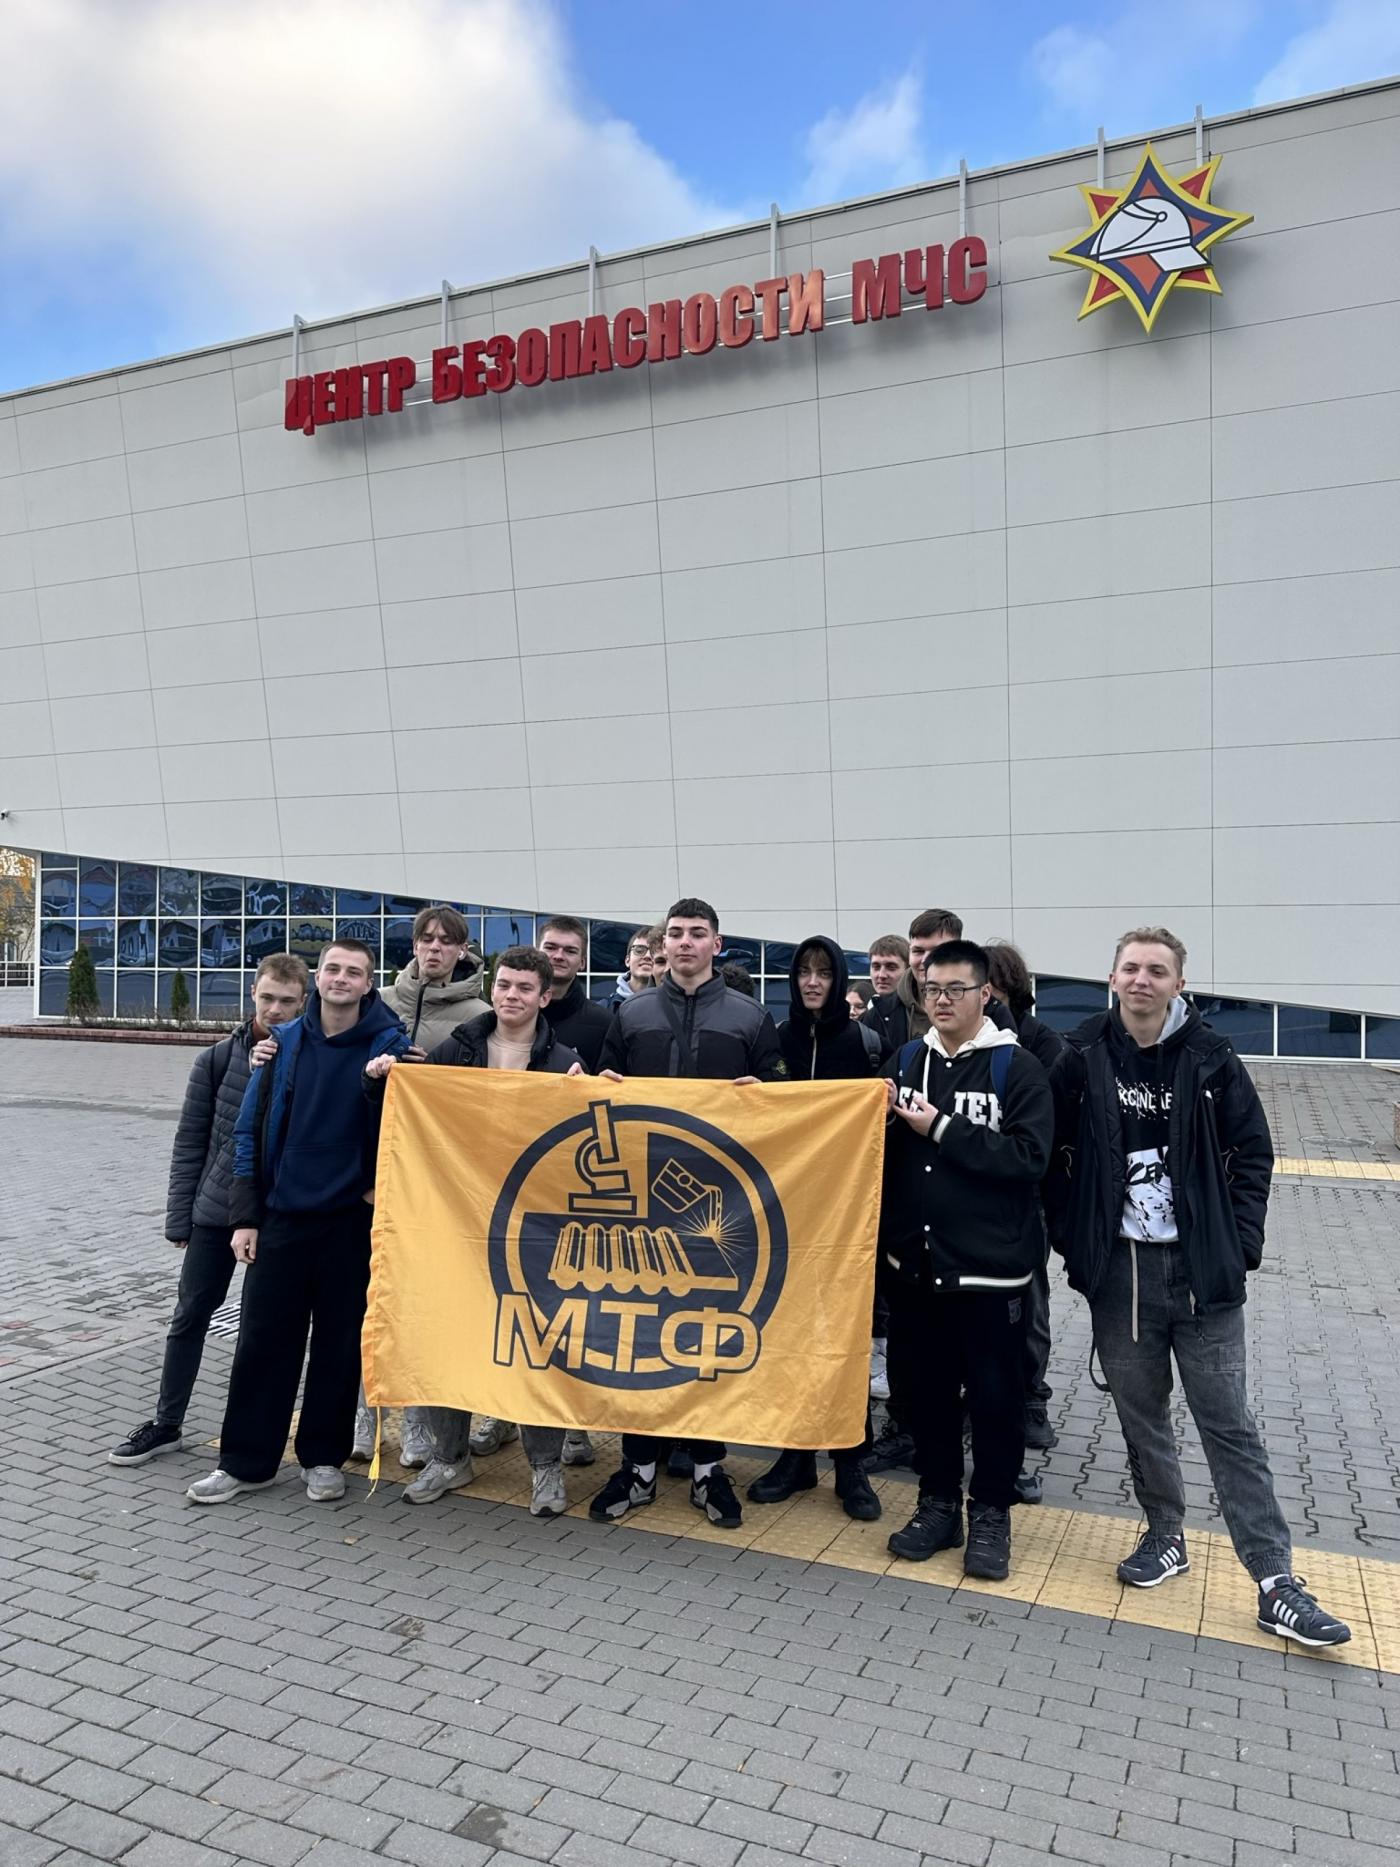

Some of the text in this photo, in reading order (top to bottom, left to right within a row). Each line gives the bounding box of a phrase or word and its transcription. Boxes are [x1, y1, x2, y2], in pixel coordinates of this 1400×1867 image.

[285, 236, 988, 435] ЦЕНТР БЕЗОПАСНОСТИ МЧС
[494, 1292, 762, 1382] МТФ
